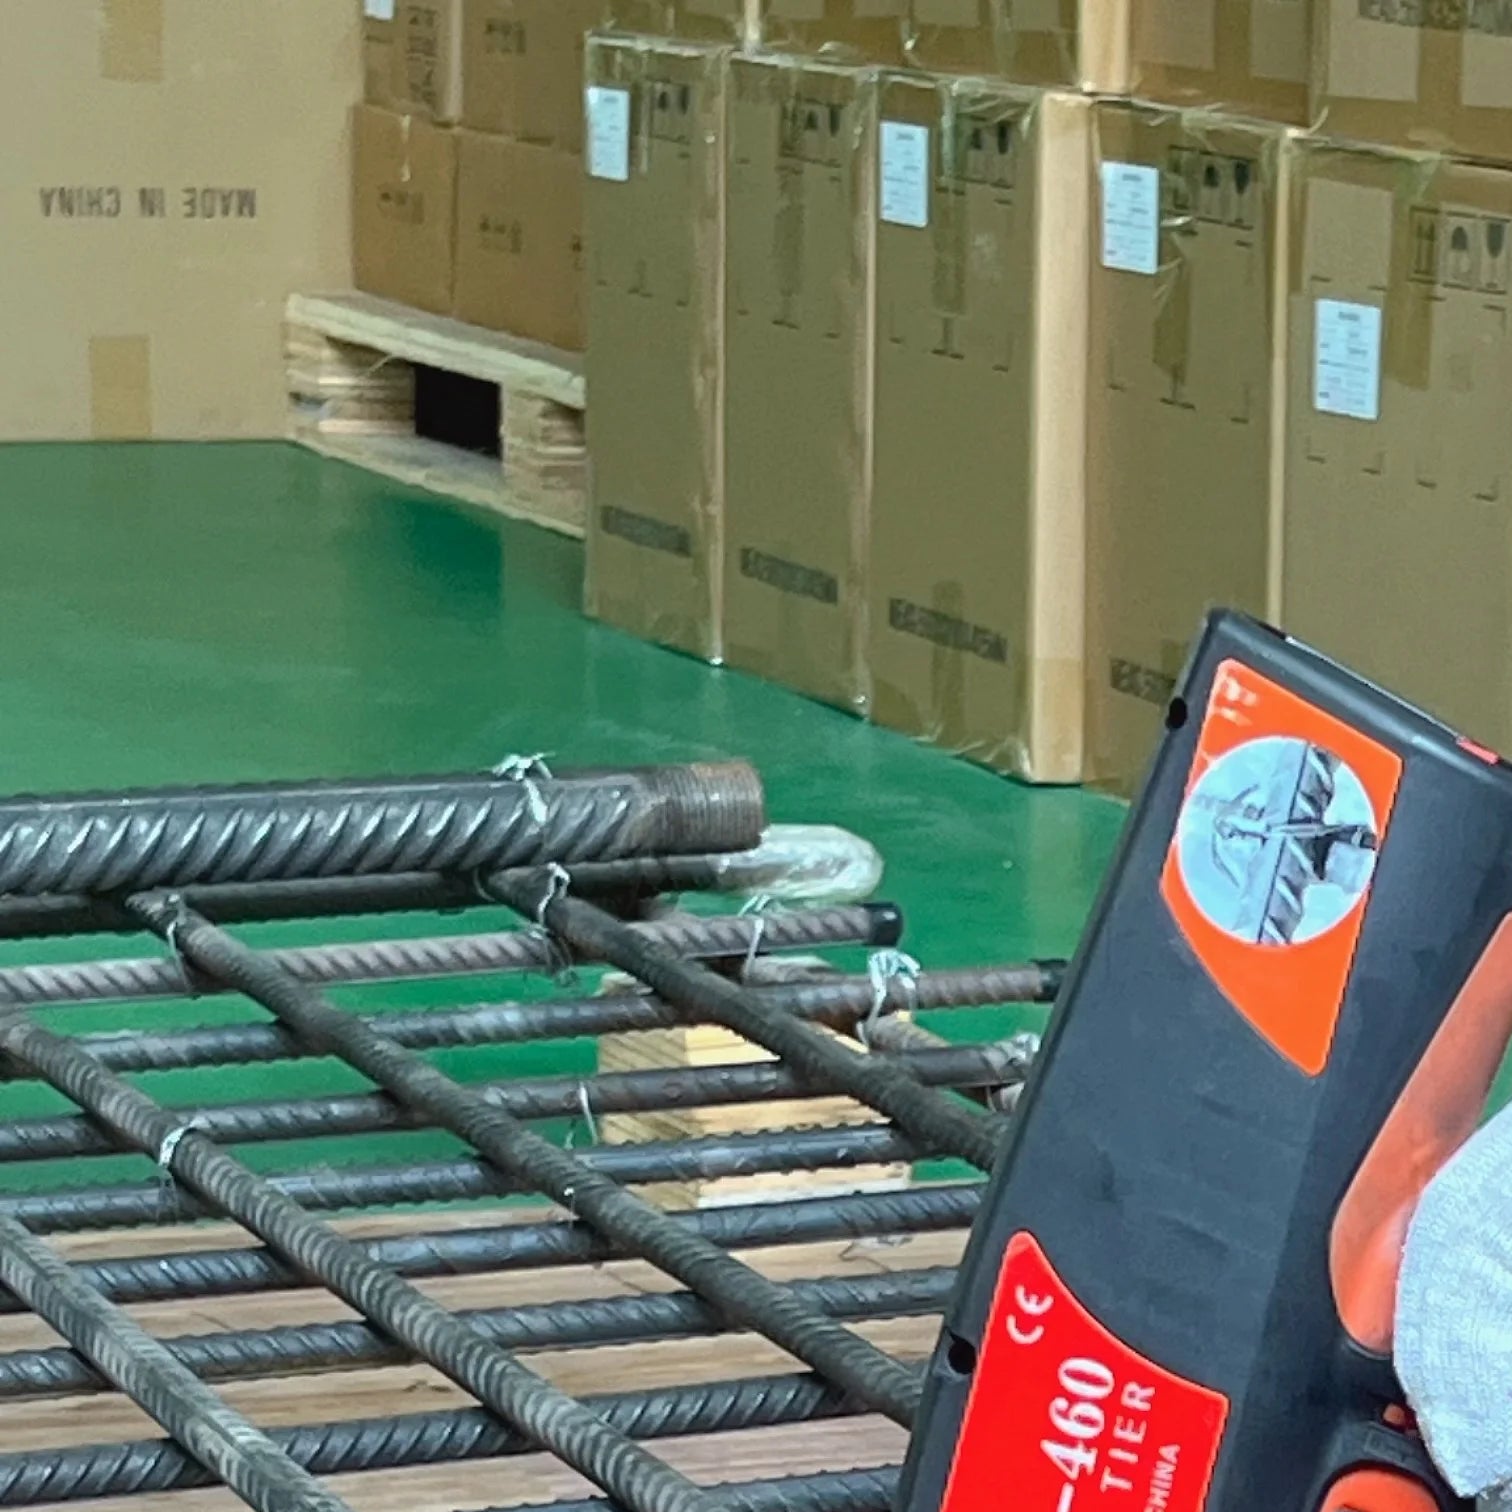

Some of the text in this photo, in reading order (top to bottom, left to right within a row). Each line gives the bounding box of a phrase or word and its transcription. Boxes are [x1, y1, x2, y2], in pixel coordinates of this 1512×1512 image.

[40, 186, 257, 219] MADE IN CHINA
[1100, 1381, 1156, 1494] TIER
